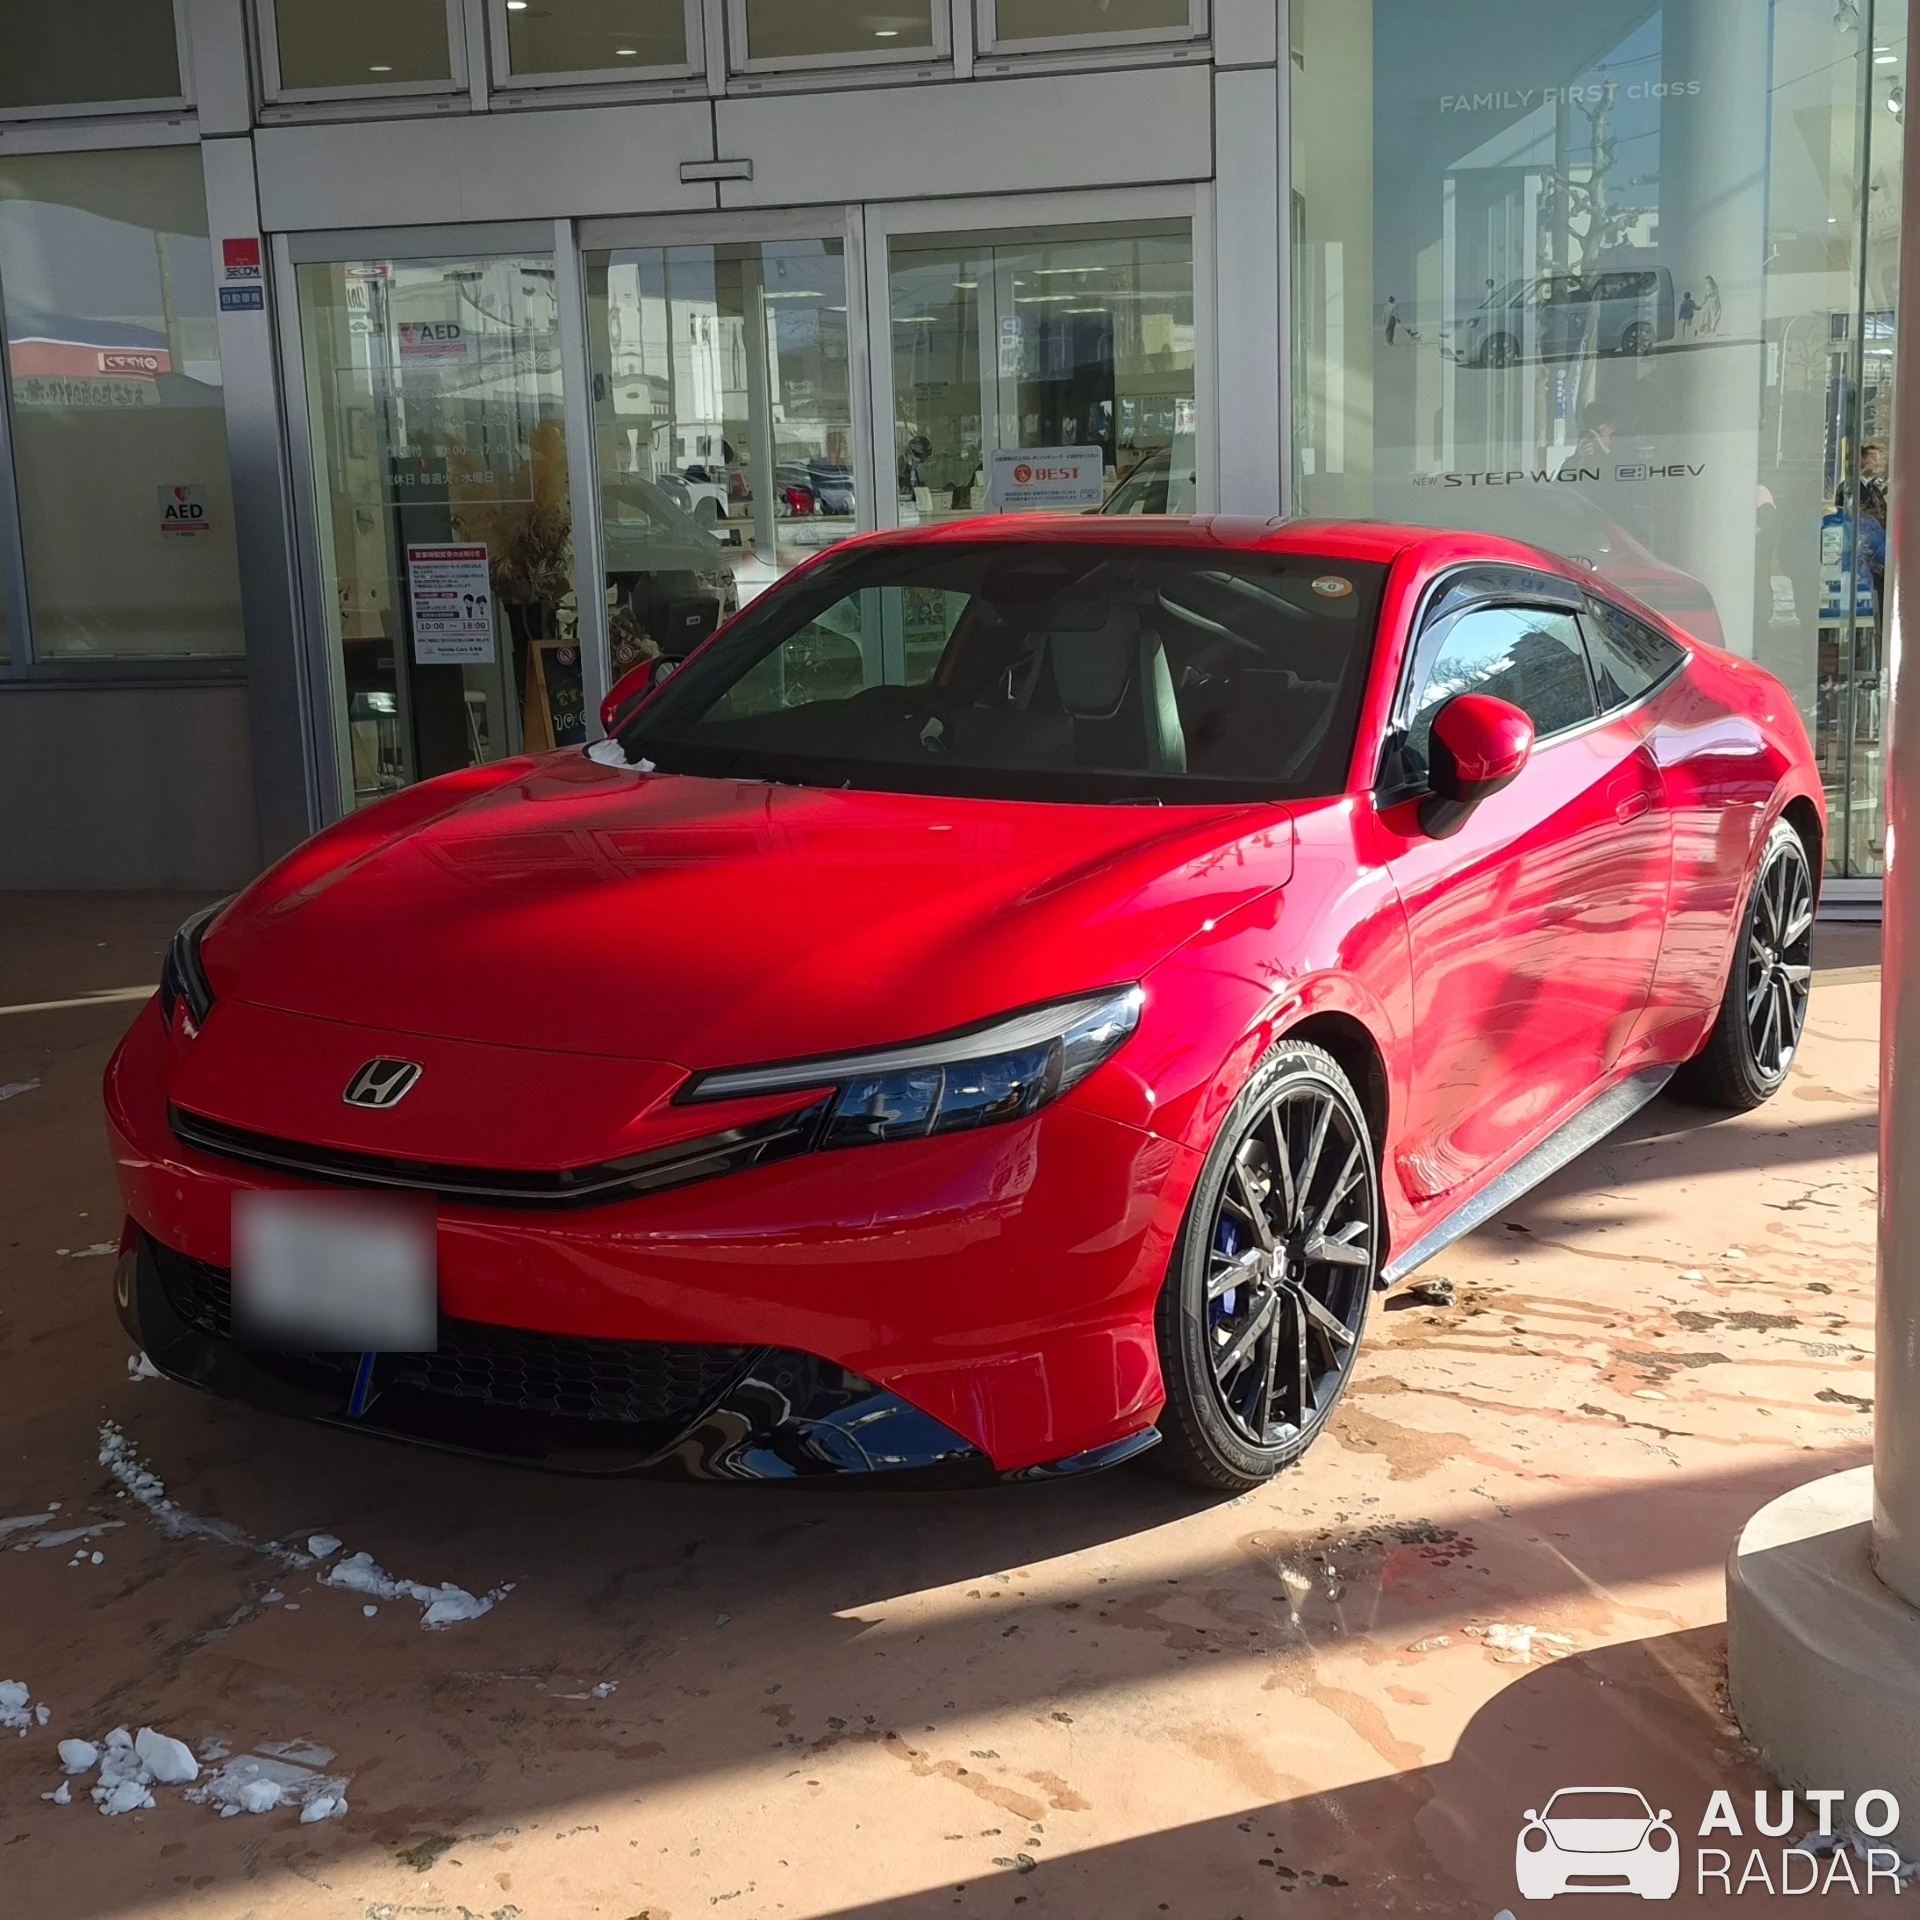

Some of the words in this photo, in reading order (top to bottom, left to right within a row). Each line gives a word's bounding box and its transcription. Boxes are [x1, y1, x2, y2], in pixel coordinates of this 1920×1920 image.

[1440, 89, 1533, 113] FAMILY
[1543, 82, 1619, 106] FIRST
[1626, 80, 1701, 100] class
[226, 266, 260, 277] SECOM
[421, 324, 461, 341] AED
[1036, 467, 1081, 481] BEST
[1412, 476, 1438, 488] NEW
[165, 504, 203, 519] AED
[421, 622, 445, 631] 10:00
[462, 621, 486, 630] 18:00
